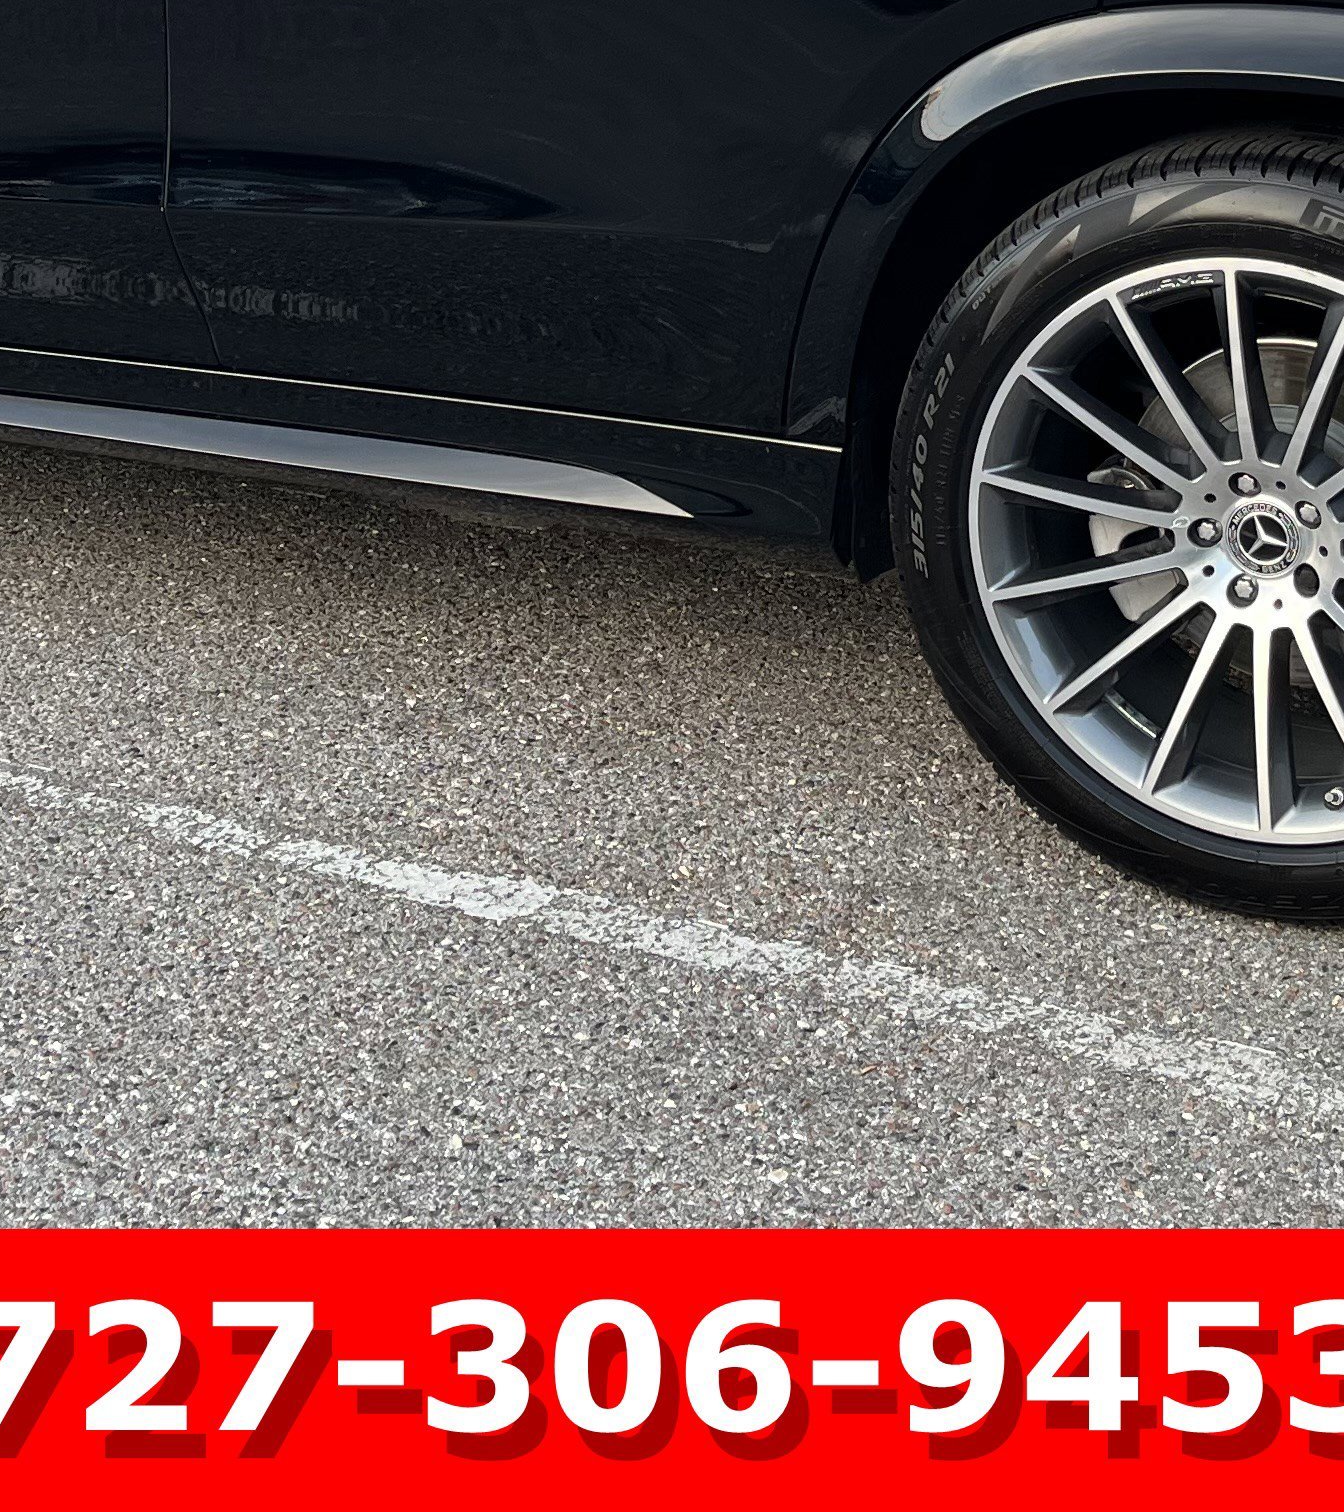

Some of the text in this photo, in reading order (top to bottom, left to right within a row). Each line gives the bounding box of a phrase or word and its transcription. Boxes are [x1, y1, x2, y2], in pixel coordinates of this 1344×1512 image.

[909, 439, 929, 579] 315/40
[922, 352, 956, 430] R21
[1232, 504, 1278, 525] MERCEDES
